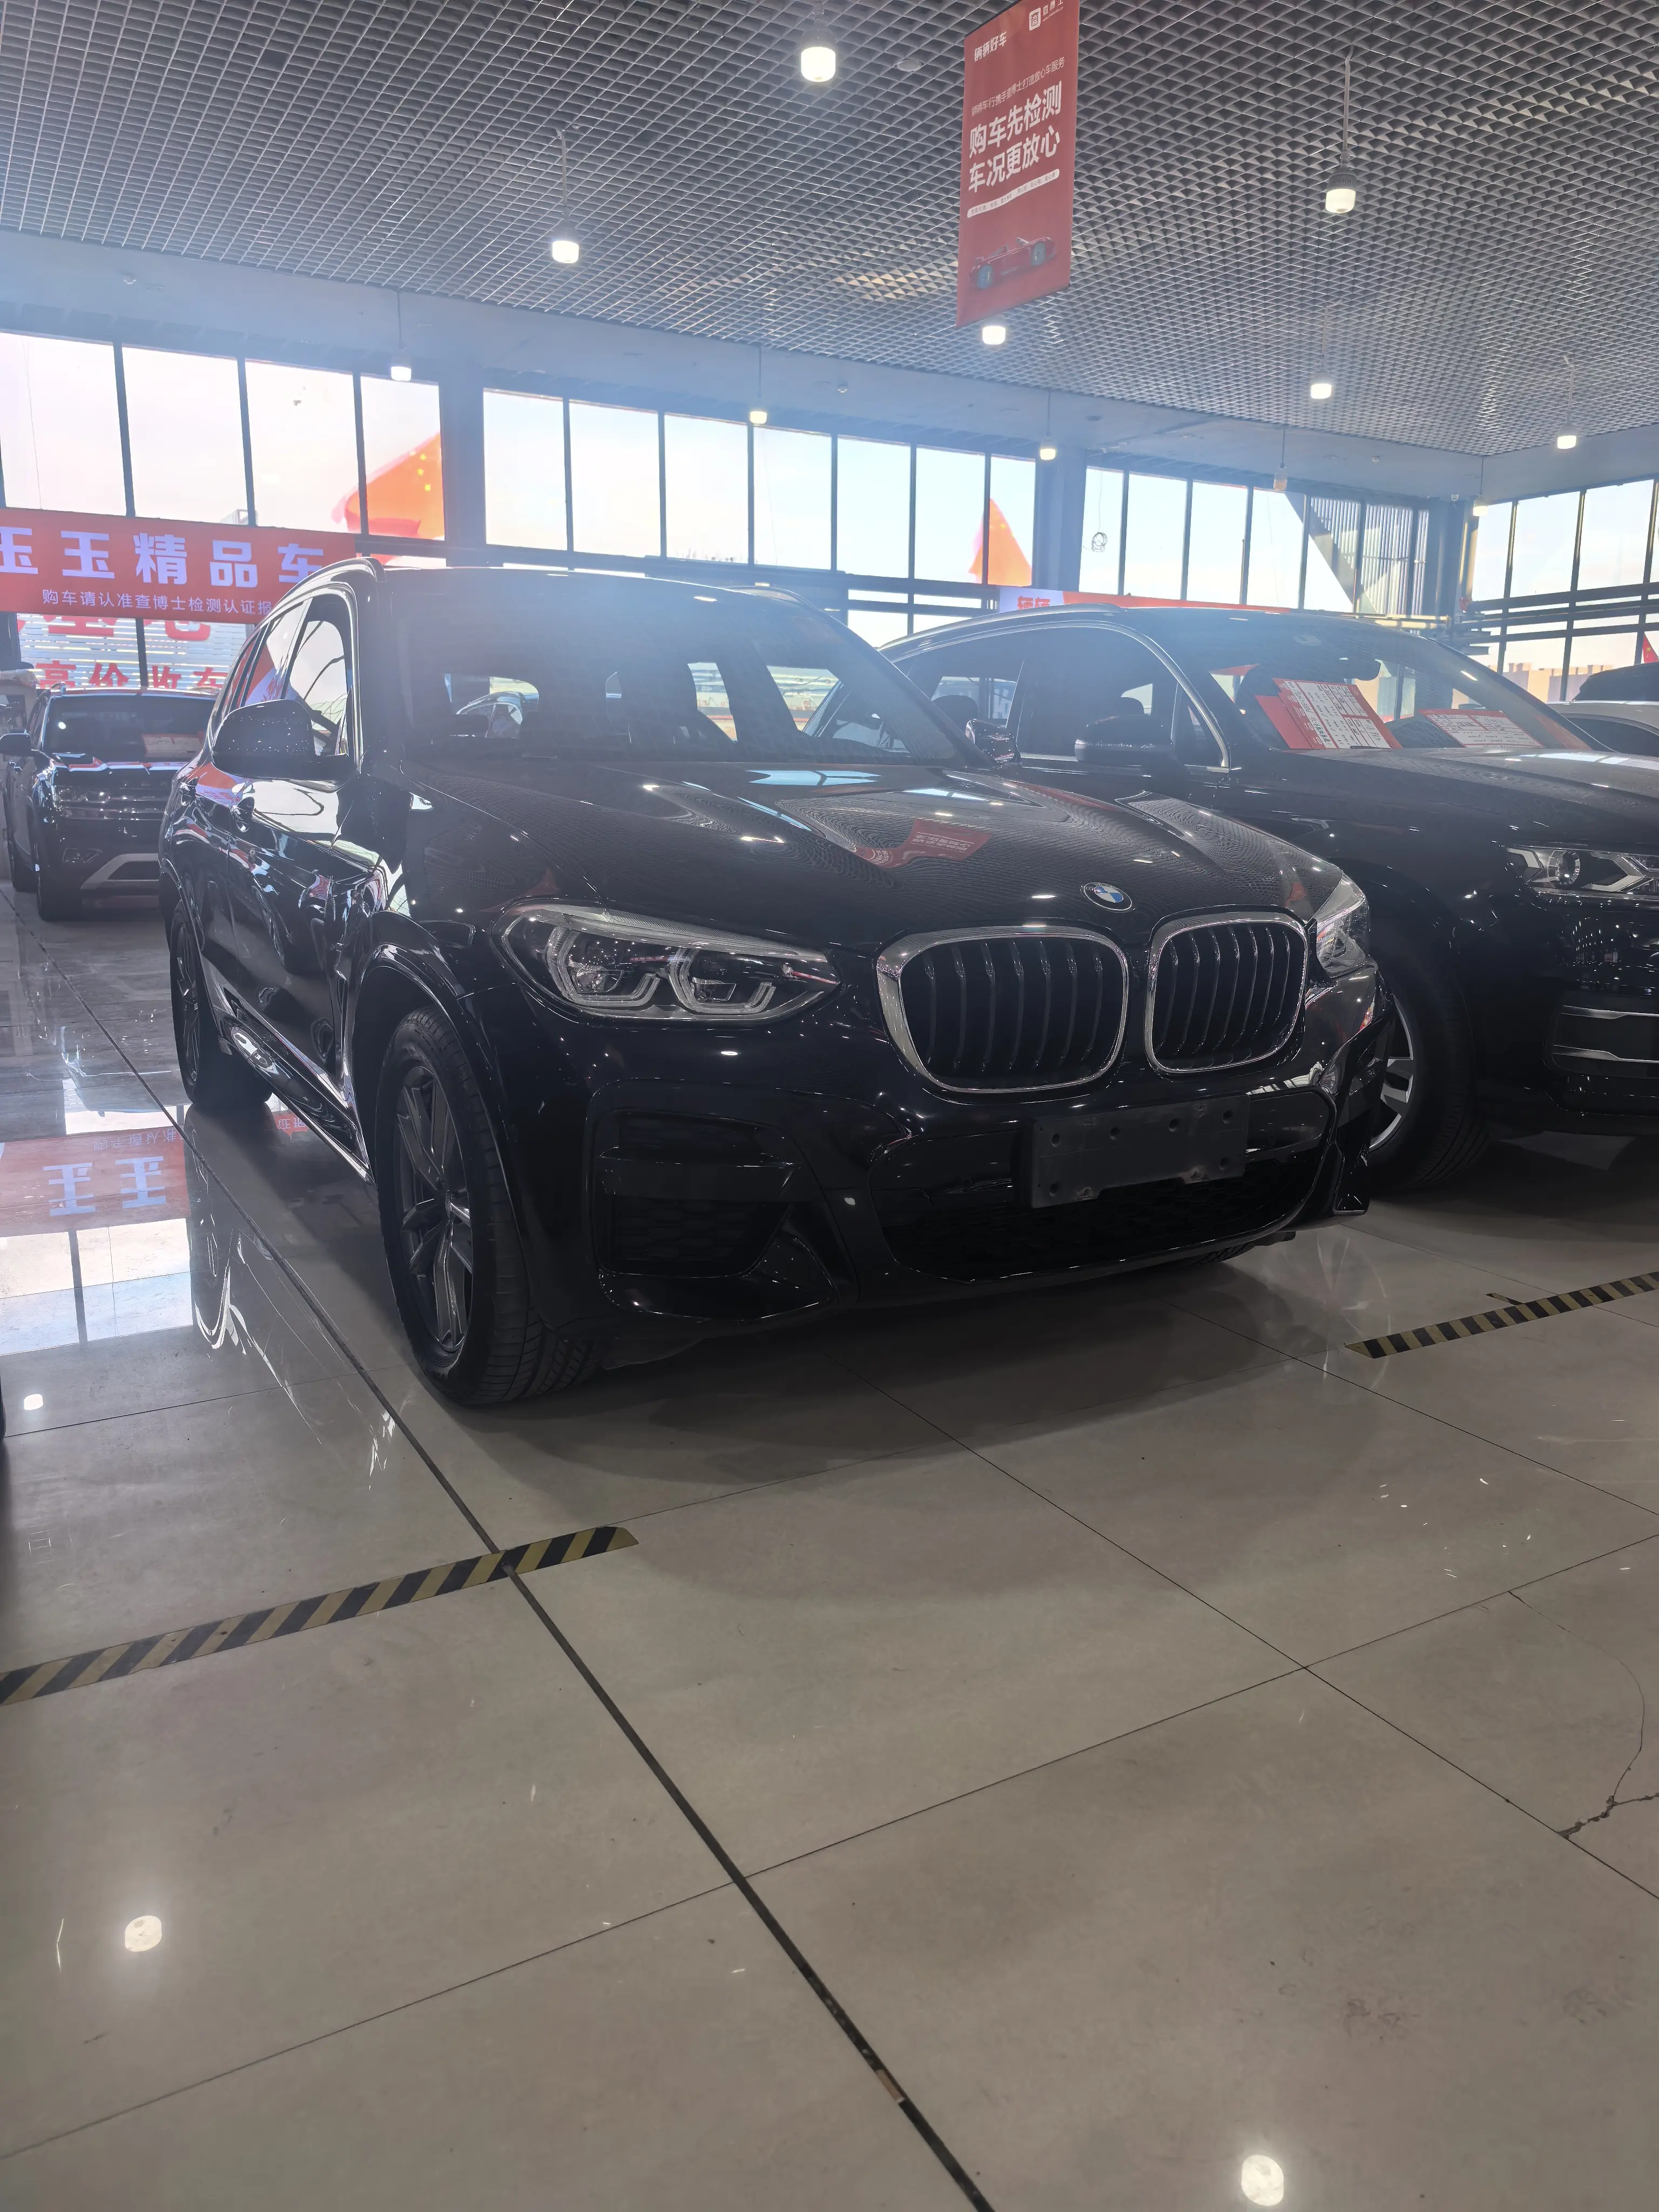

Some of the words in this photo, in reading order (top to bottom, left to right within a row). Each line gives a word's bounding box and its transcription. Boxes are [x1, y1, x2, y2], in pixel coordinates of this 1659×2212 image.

[974, 31, 1007, 62] 辆辆好车
[969, 80, 1062, 159] 购车先检测
[968, 125, 1060, 193] 车况更放心
[43, 589, 272, 615] 购车请认准查博士检测认证报
